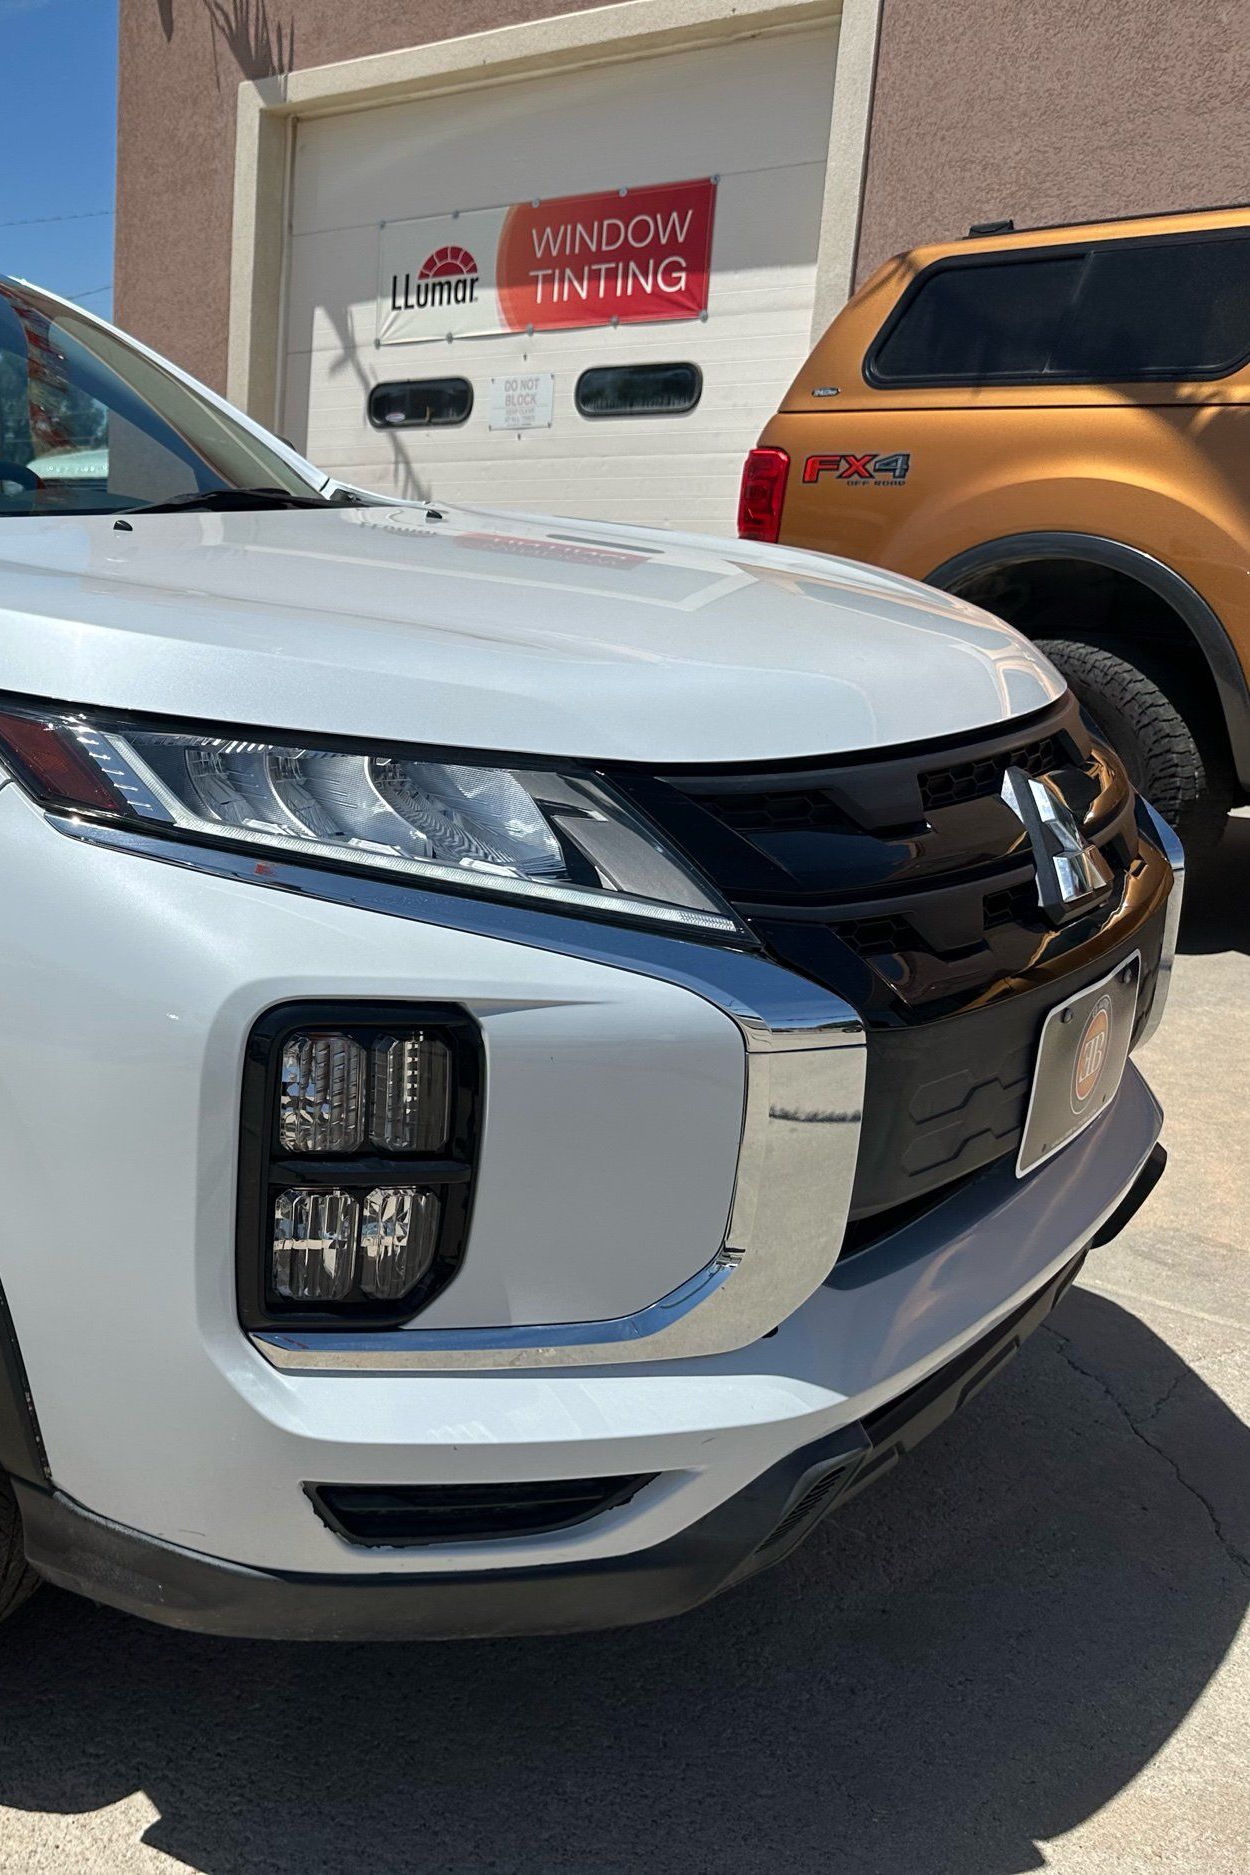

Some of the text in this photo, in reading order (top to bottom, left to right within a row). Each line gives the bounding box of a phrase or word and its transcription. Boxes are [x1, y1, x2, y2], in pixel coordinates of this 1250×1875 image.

[531, 208, 694, 259] WINDOW
[391, 273, 478, 311] LLumar
[529, 255, 688, 305] TINTING
[504, 378, 540, 393] DO NOT
[505, 393, 537, 407] BLOCK
[802, 453, 911, 484] FX4
[846, 479, 870, 487] OFF
